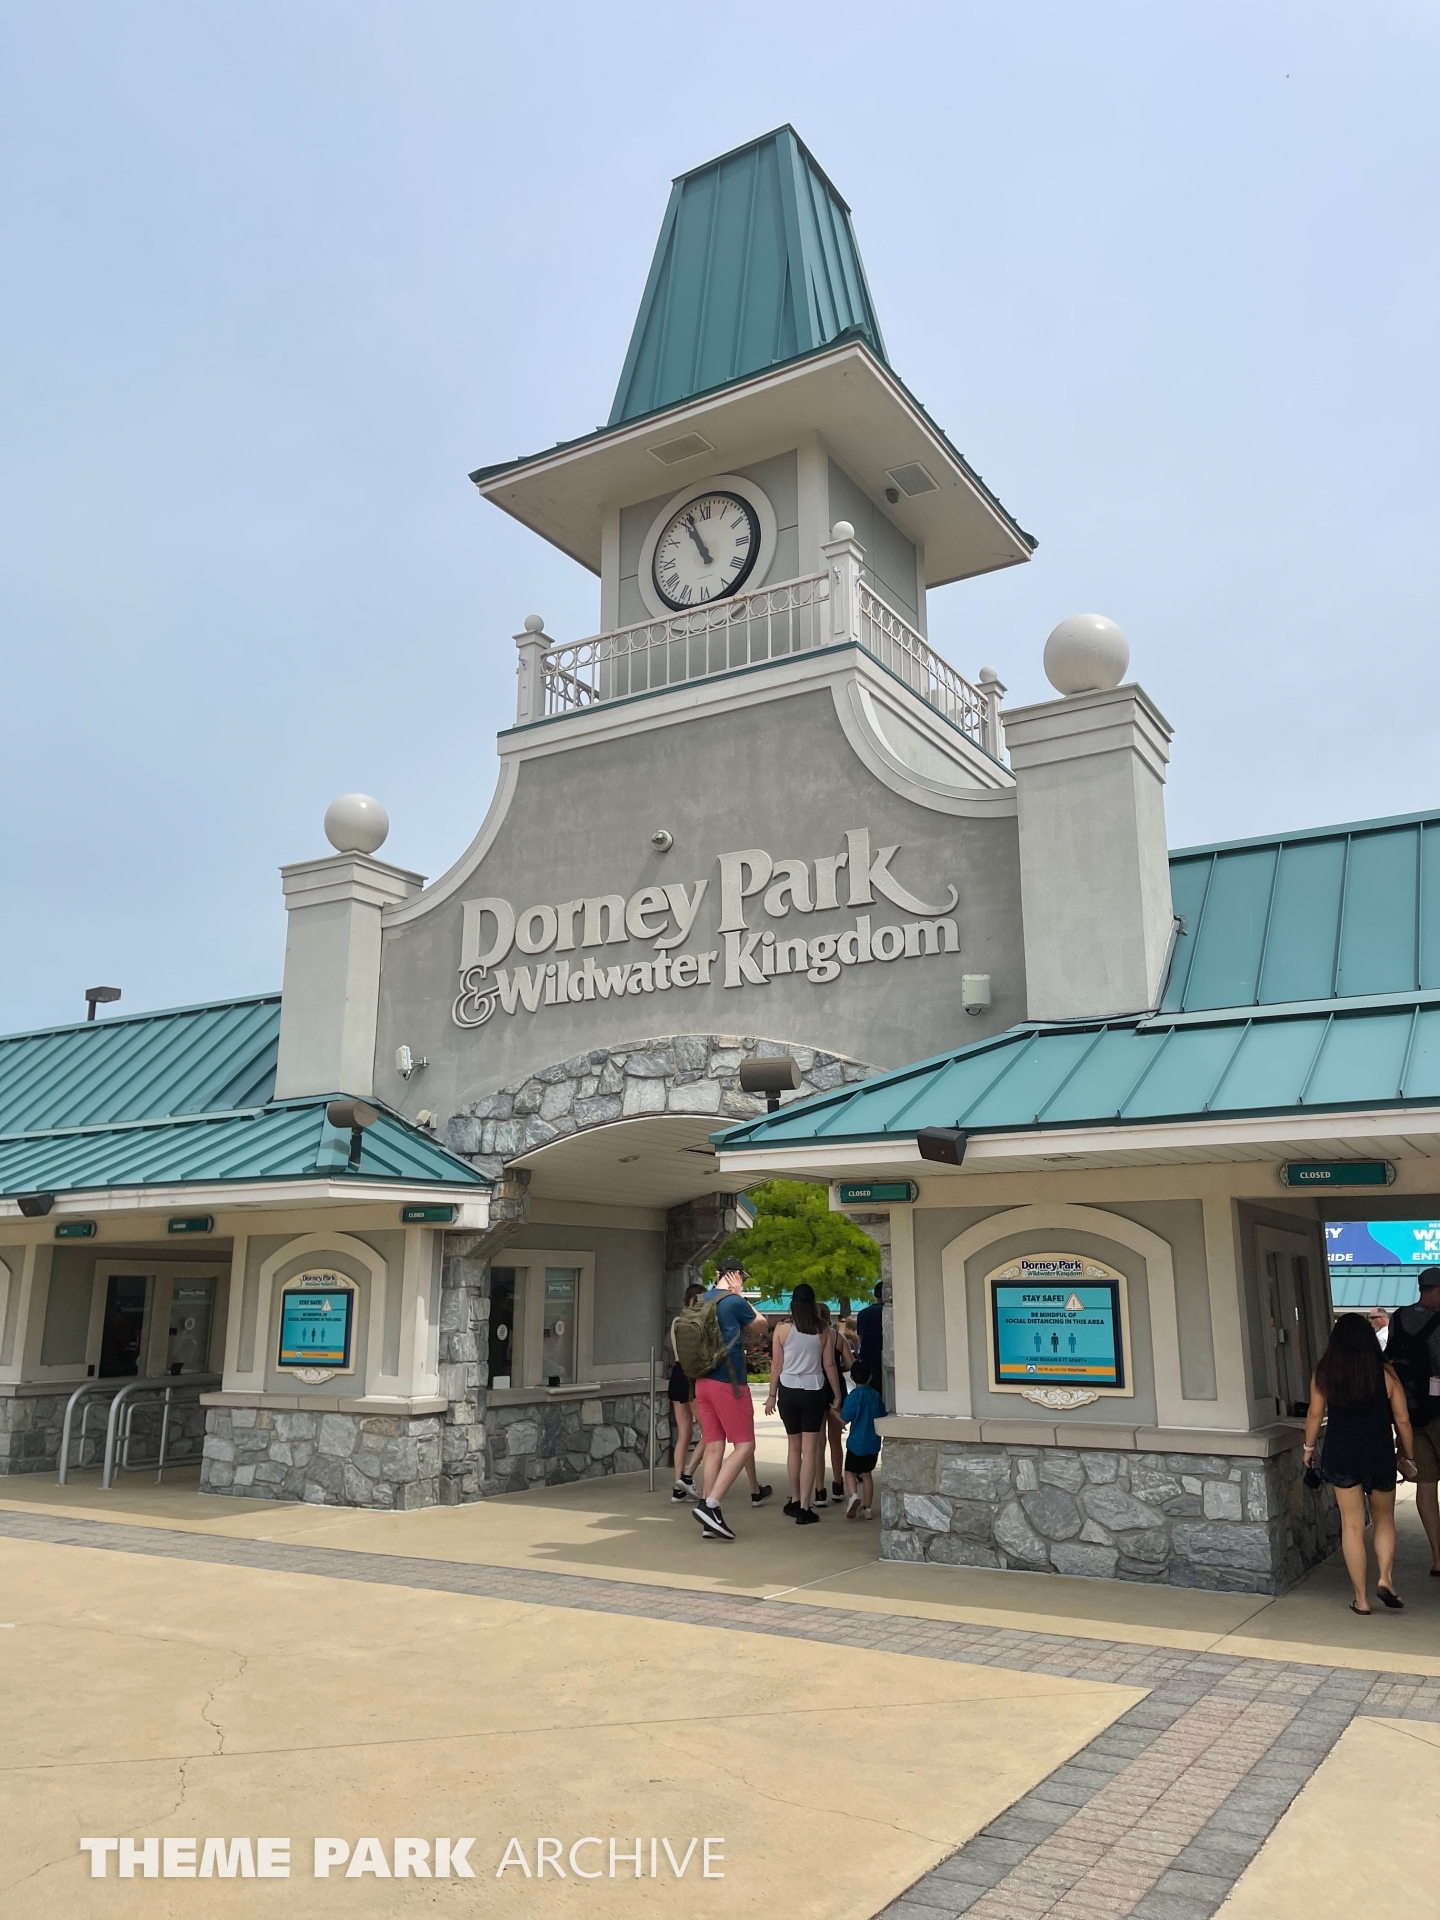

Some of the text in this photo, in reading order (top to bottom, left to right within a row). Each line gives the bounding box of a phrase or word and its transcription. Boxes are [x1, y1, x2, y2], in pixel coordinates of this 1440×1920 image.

[459, 827, 960, 972] Dorney Park
[451, 914, 961, 1029] & Wildwater Kingdom
[1299, 1171, 1332, 1179] CLOSED
[1021, 1260, 1082, 1272] Dorney Park
